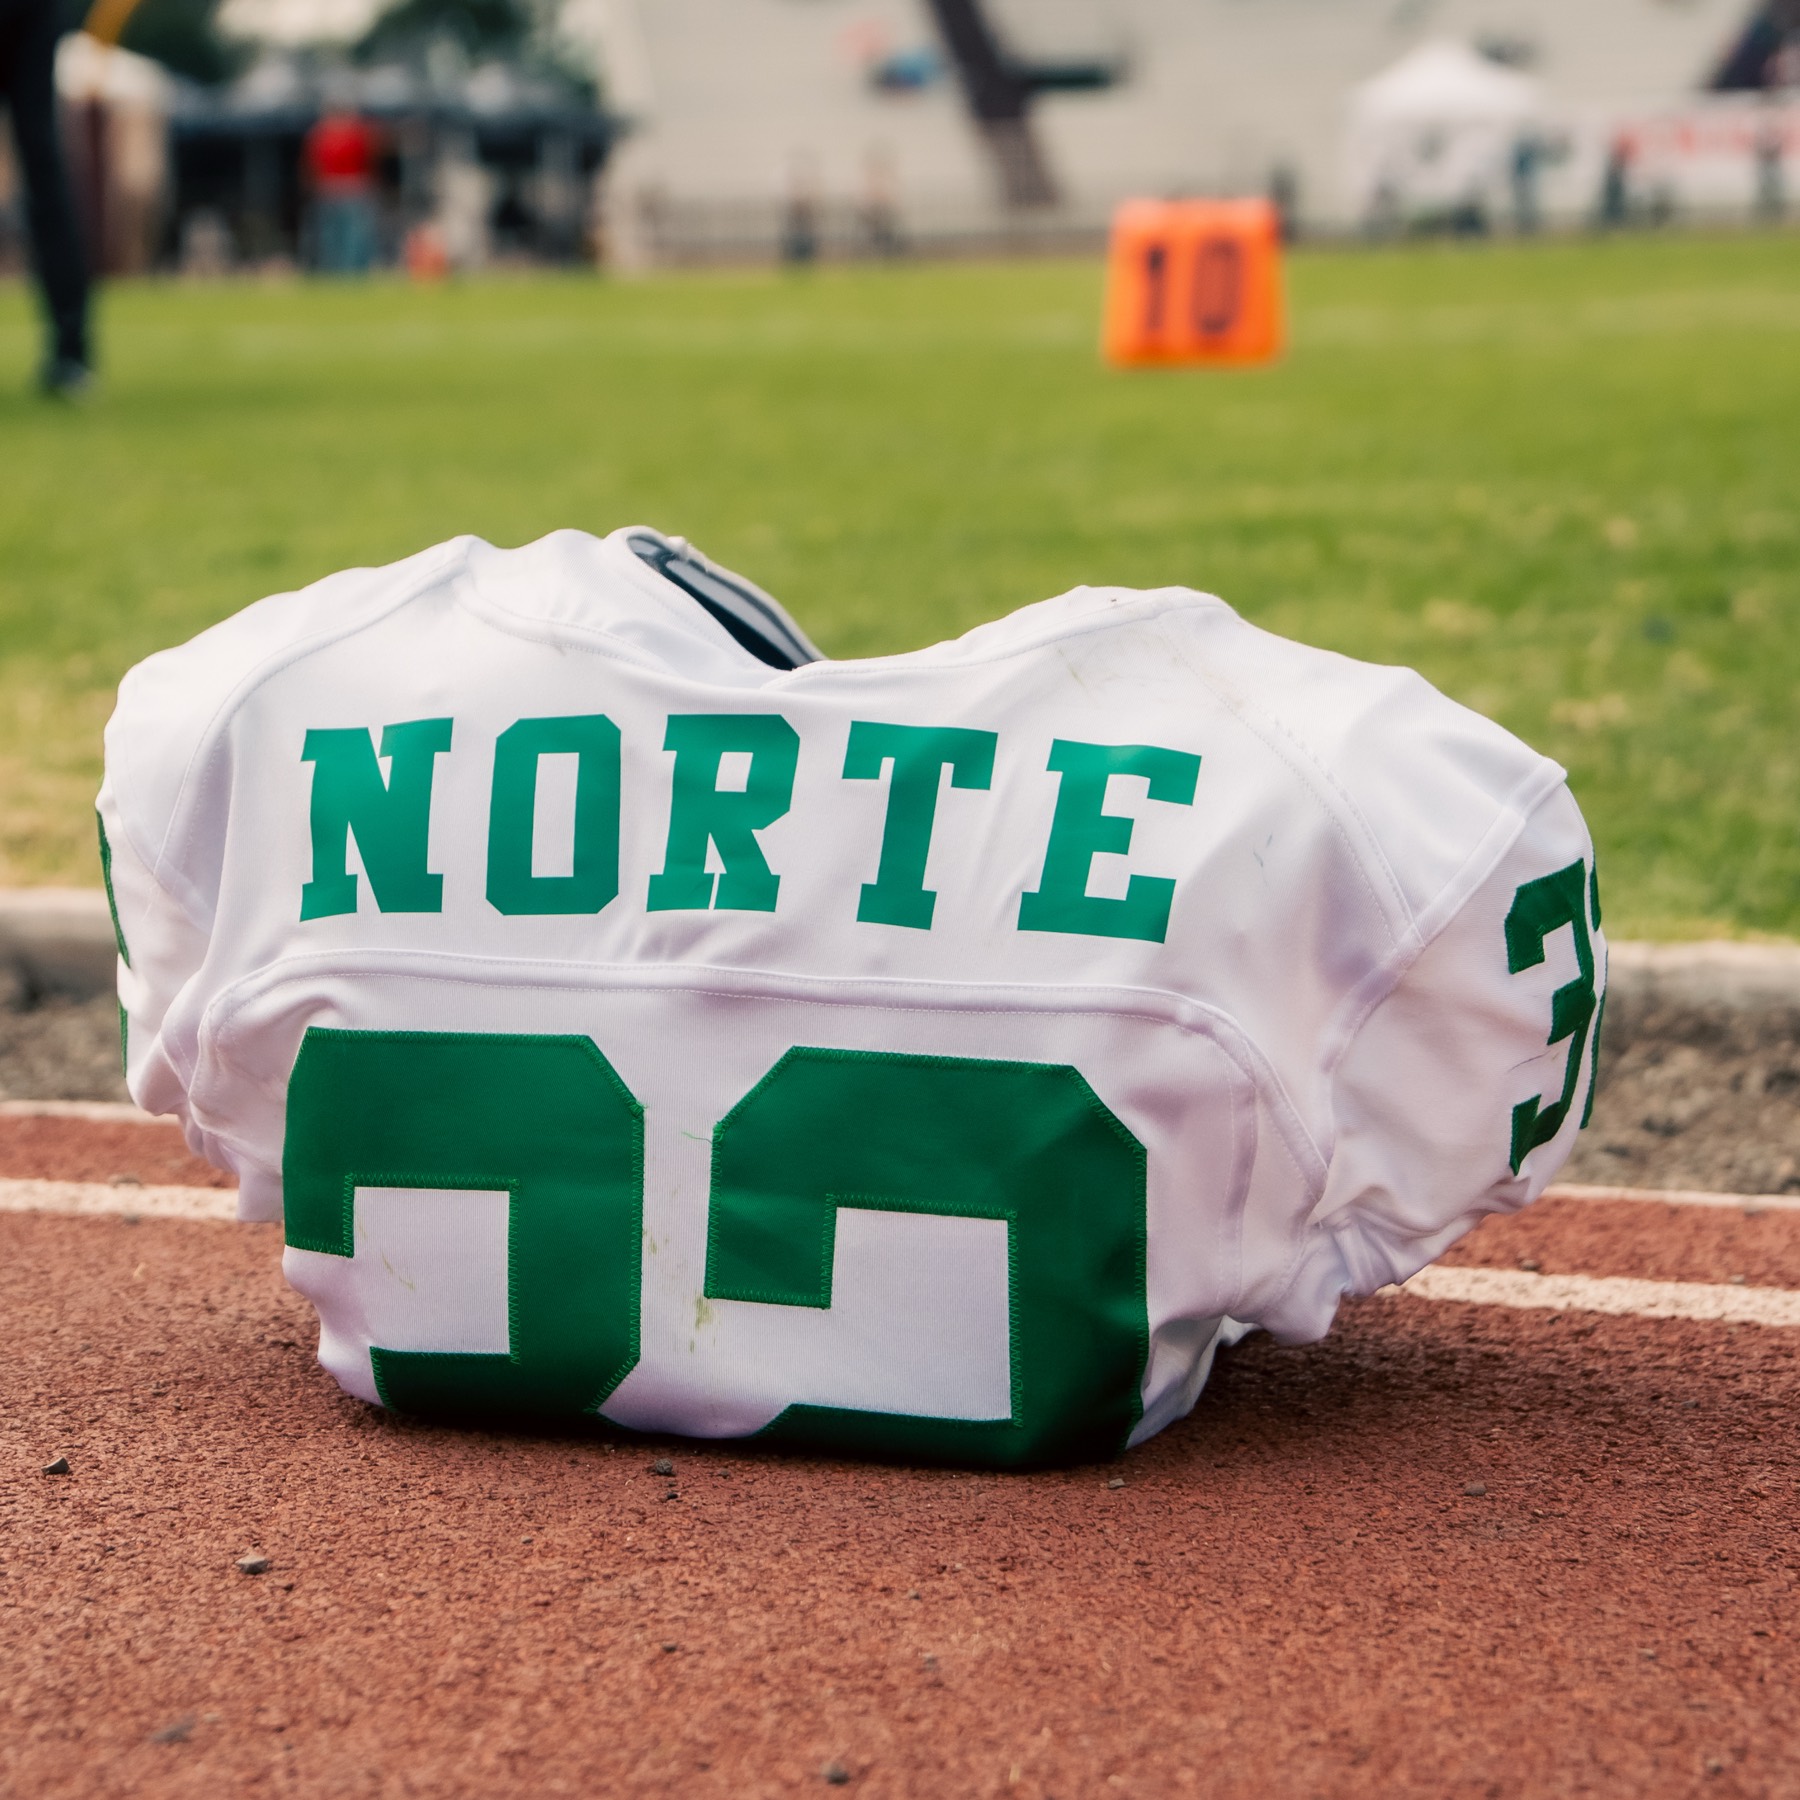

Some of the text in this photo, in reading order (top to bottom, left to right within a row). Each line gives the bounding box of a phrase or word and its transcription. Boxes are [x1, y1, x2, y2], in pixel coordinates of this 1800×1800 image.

[1141, 236, 1246, 335] 10
[299, 713, 1202, 945] NORTE
[1504, 857, 1608, 1176] 3
